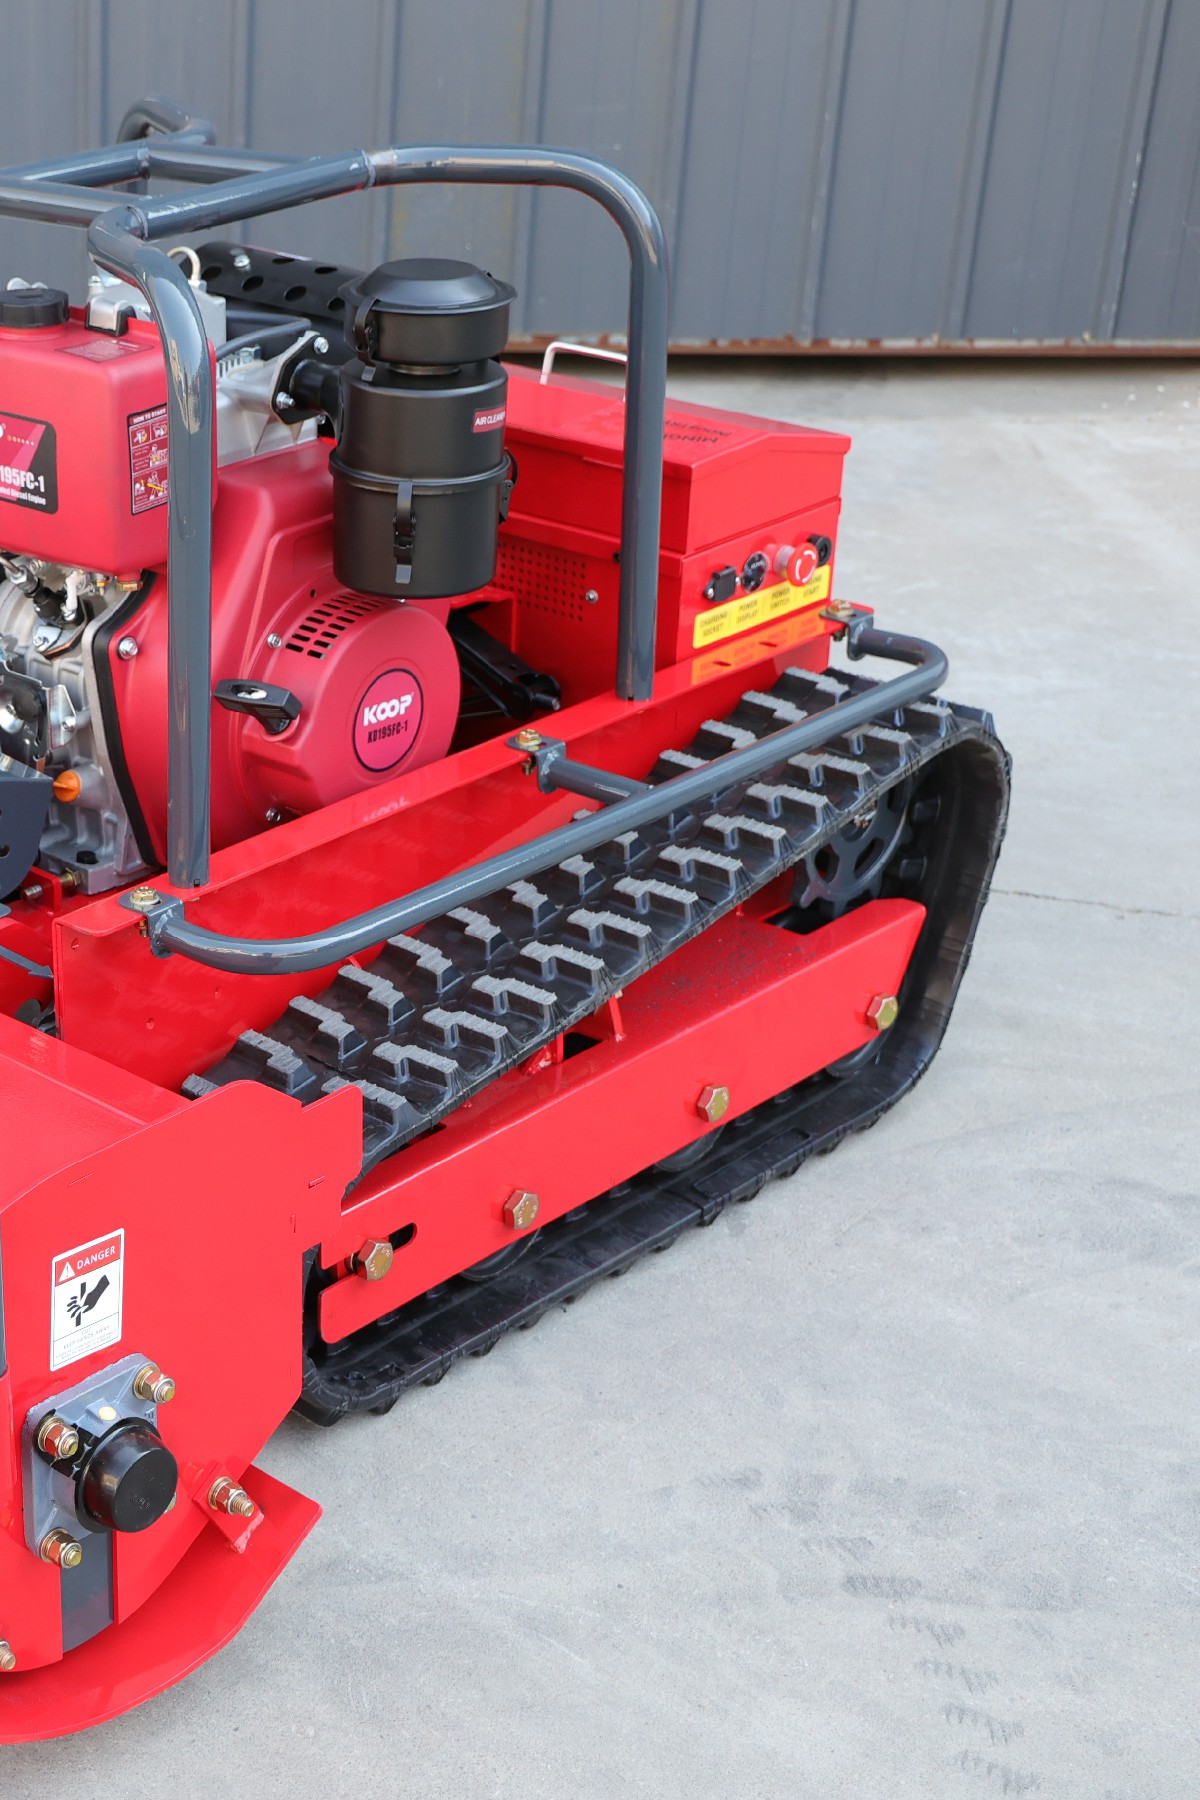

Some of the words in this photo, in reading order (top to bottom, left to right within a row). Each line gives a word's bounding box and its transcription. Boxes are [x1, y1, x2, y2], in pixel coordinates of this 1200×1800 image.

[475, 416, 487, 426] AIR
[28, 492, 46, 505] Engine
[771, 586, 790, 599] POWER
[739, 599, 757, 612] POWER
[363, 694, 413, 727] KOOP
[368, 720, 408, 743] KD195FC-1
[76, 1245, 115, 1270] DANGER
